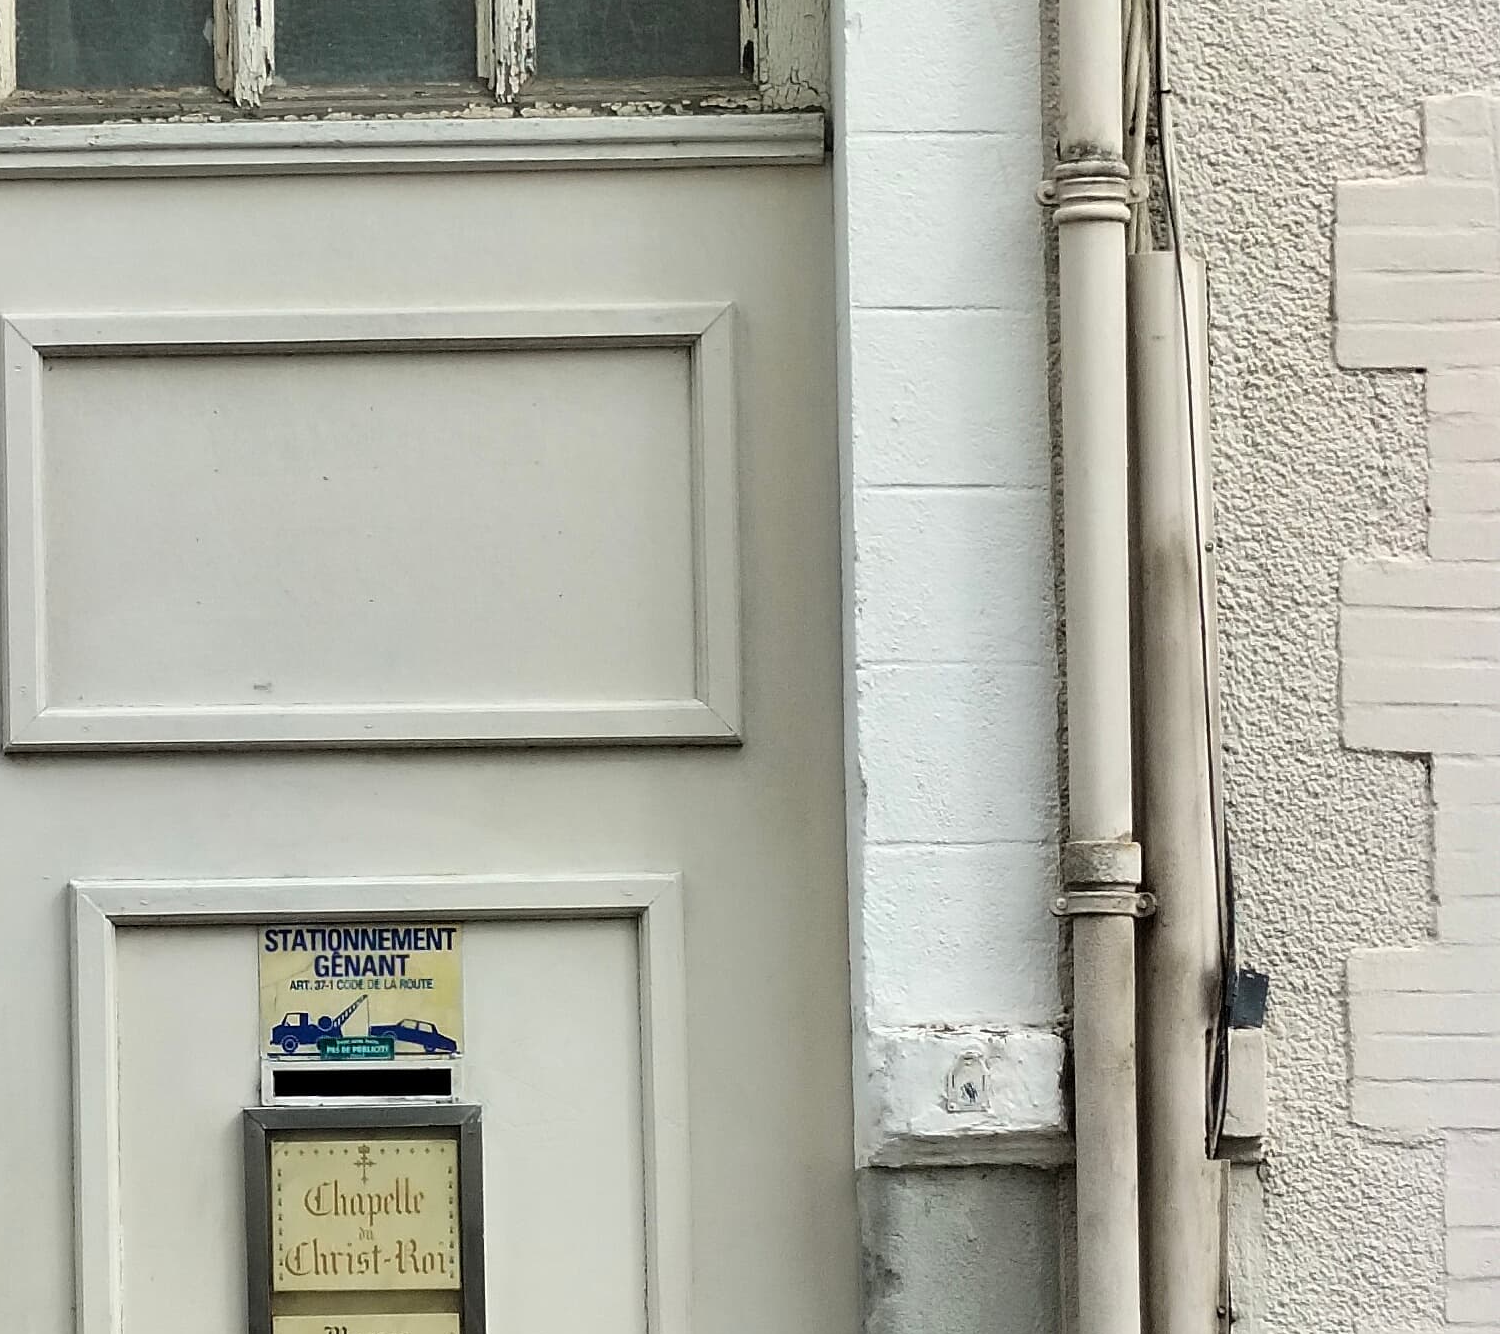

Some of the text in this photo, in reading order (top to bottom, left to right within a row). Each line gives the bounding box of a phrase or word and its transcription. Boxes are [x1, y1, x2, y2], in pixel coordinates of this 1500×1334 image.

[265, 927, 457, 952] STATIONNEMENT
[314, 952, 410, 977] GÊNANT
[289, 979, 433, 990] ART. 37-1 CODE DE LA ROUTE
[304, 1177, 424, 1227] Chapelle
[358, 1227, 374, 1241] du
[284, 1238, 447, 1276] Christ-Roi
